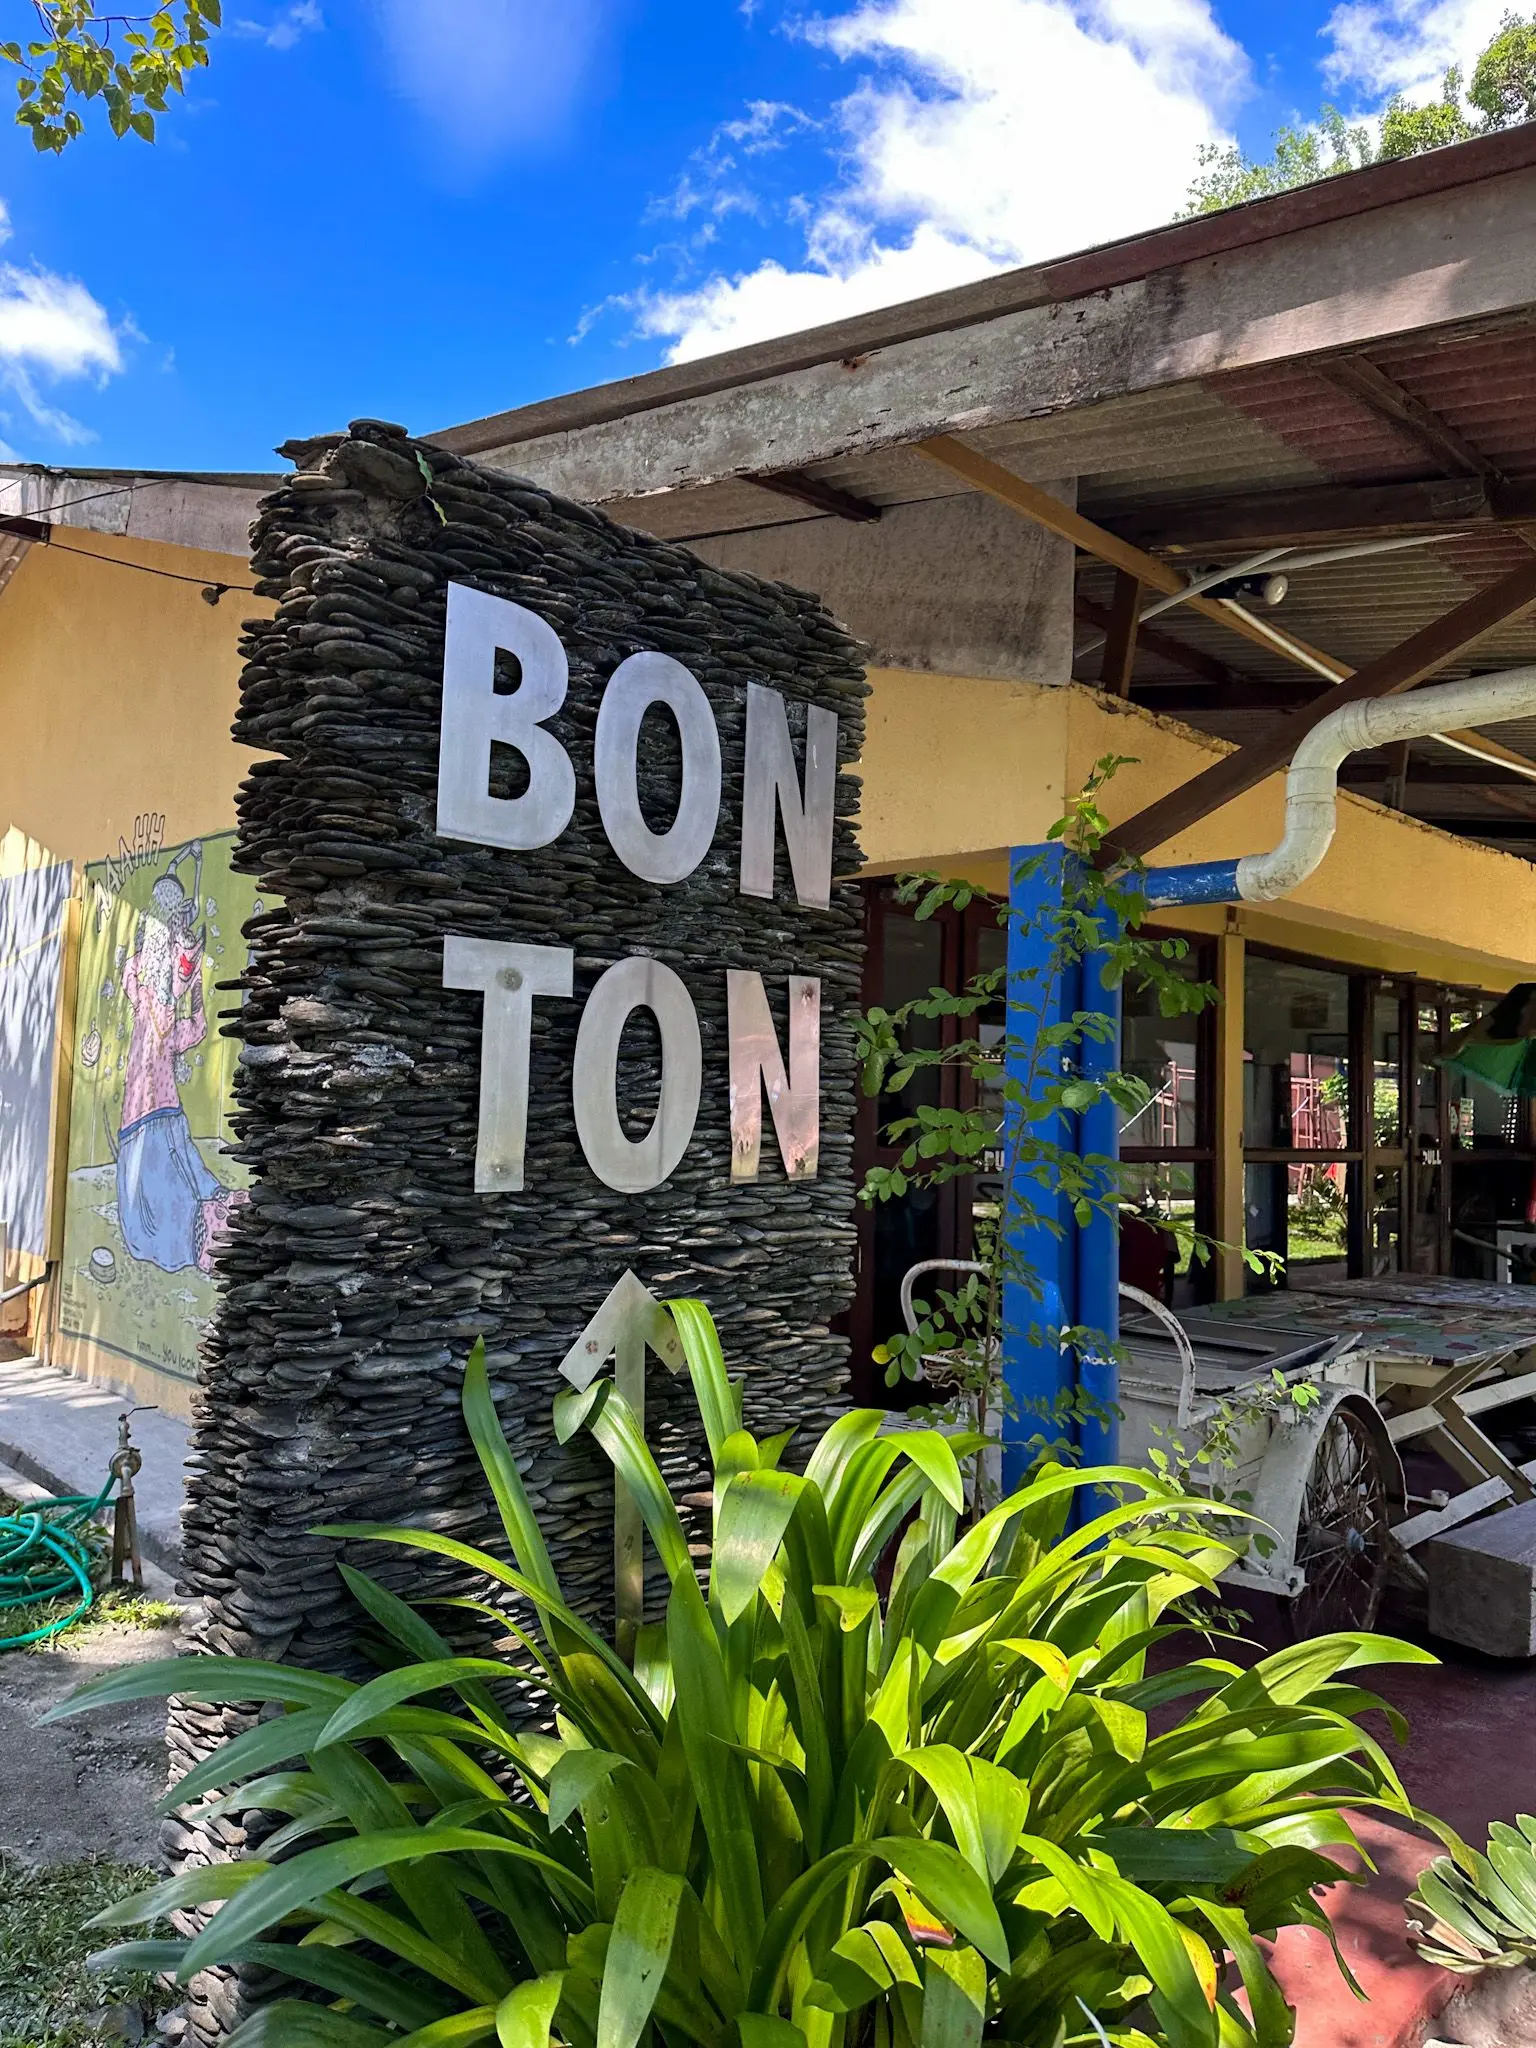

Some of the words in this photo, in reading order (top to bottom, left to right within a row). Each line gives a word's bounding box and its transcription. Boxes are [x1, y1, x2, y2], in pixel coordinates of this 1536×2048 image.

[96, 812, 165, 933] AAAHH
[436, 581, 838, 910] BON
[443, 935, 821, 1194] TON
